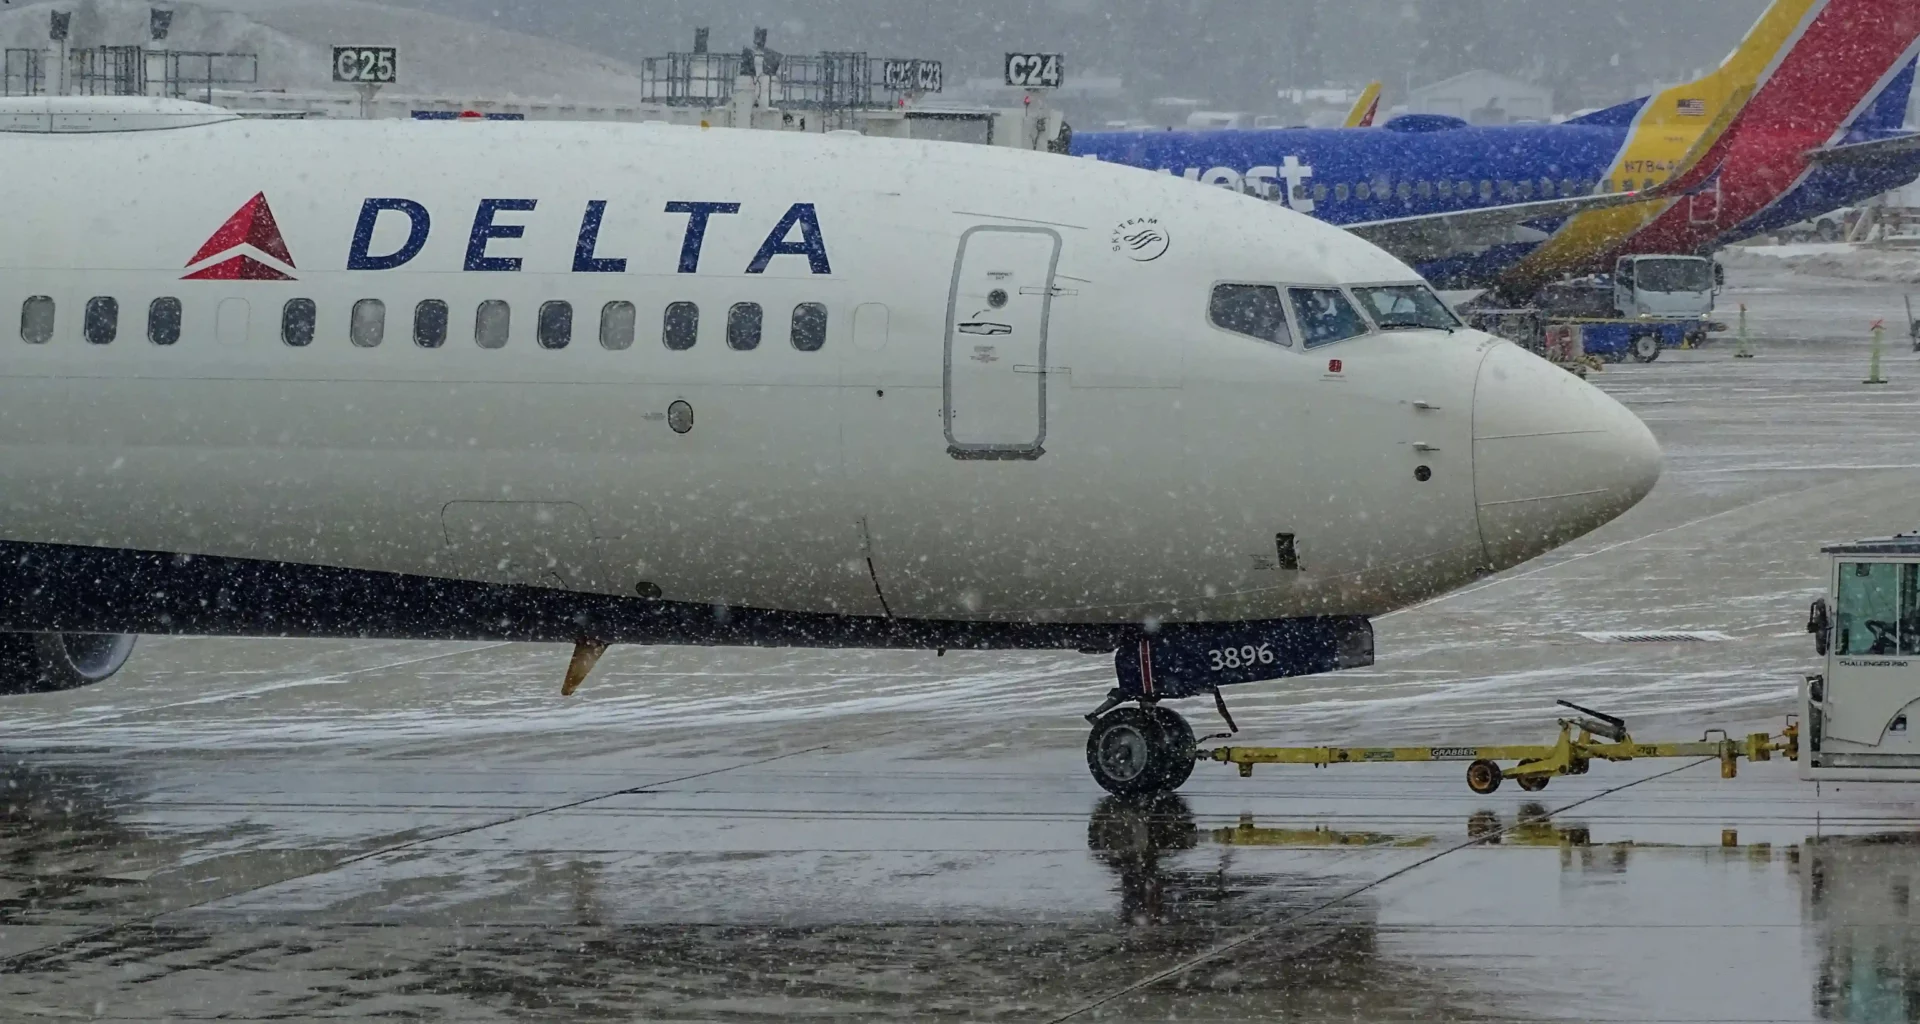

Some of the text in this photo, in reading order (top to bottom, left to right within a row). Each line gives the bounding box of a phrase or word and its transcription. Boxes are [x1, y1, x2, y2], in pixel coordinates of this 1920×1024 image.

[337, 50, 393, 81] C25
[918, 62, 941, 90] C23
[1008, 55, 1058, 86] C24
[346, 197, 832, 275] DELTA
[1111, 217, 1158, 252] SKYTEAM
[1207, 642, 1275, 671] 3896
[1839, 660, 1891, 668] CHALLENGER
[1431, 748, 1476, 757] GRABBER
